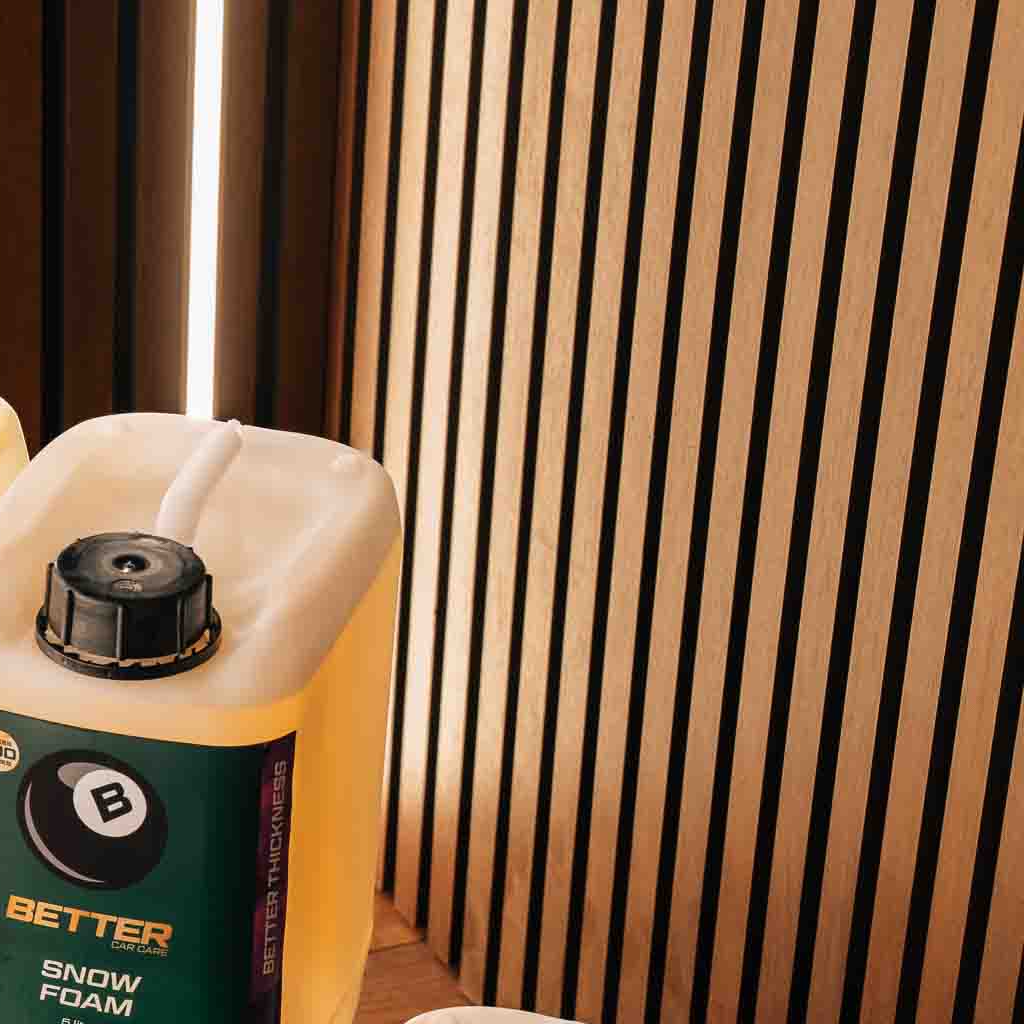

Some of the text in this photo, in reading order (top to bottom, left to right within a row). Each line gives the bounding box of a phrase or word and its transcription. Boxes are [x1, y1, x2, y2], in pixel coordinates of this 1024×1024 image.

[90, 781, 133, 823] B
[263, 760, 287, 975] BETTER THICKNESS
[6, 895, 173, 949] BETTER
[111, 941, 168, 958] CAR CARE
[41, 959, 143, 993] SNOW
[39, 983, 133, 1017] FOAM
